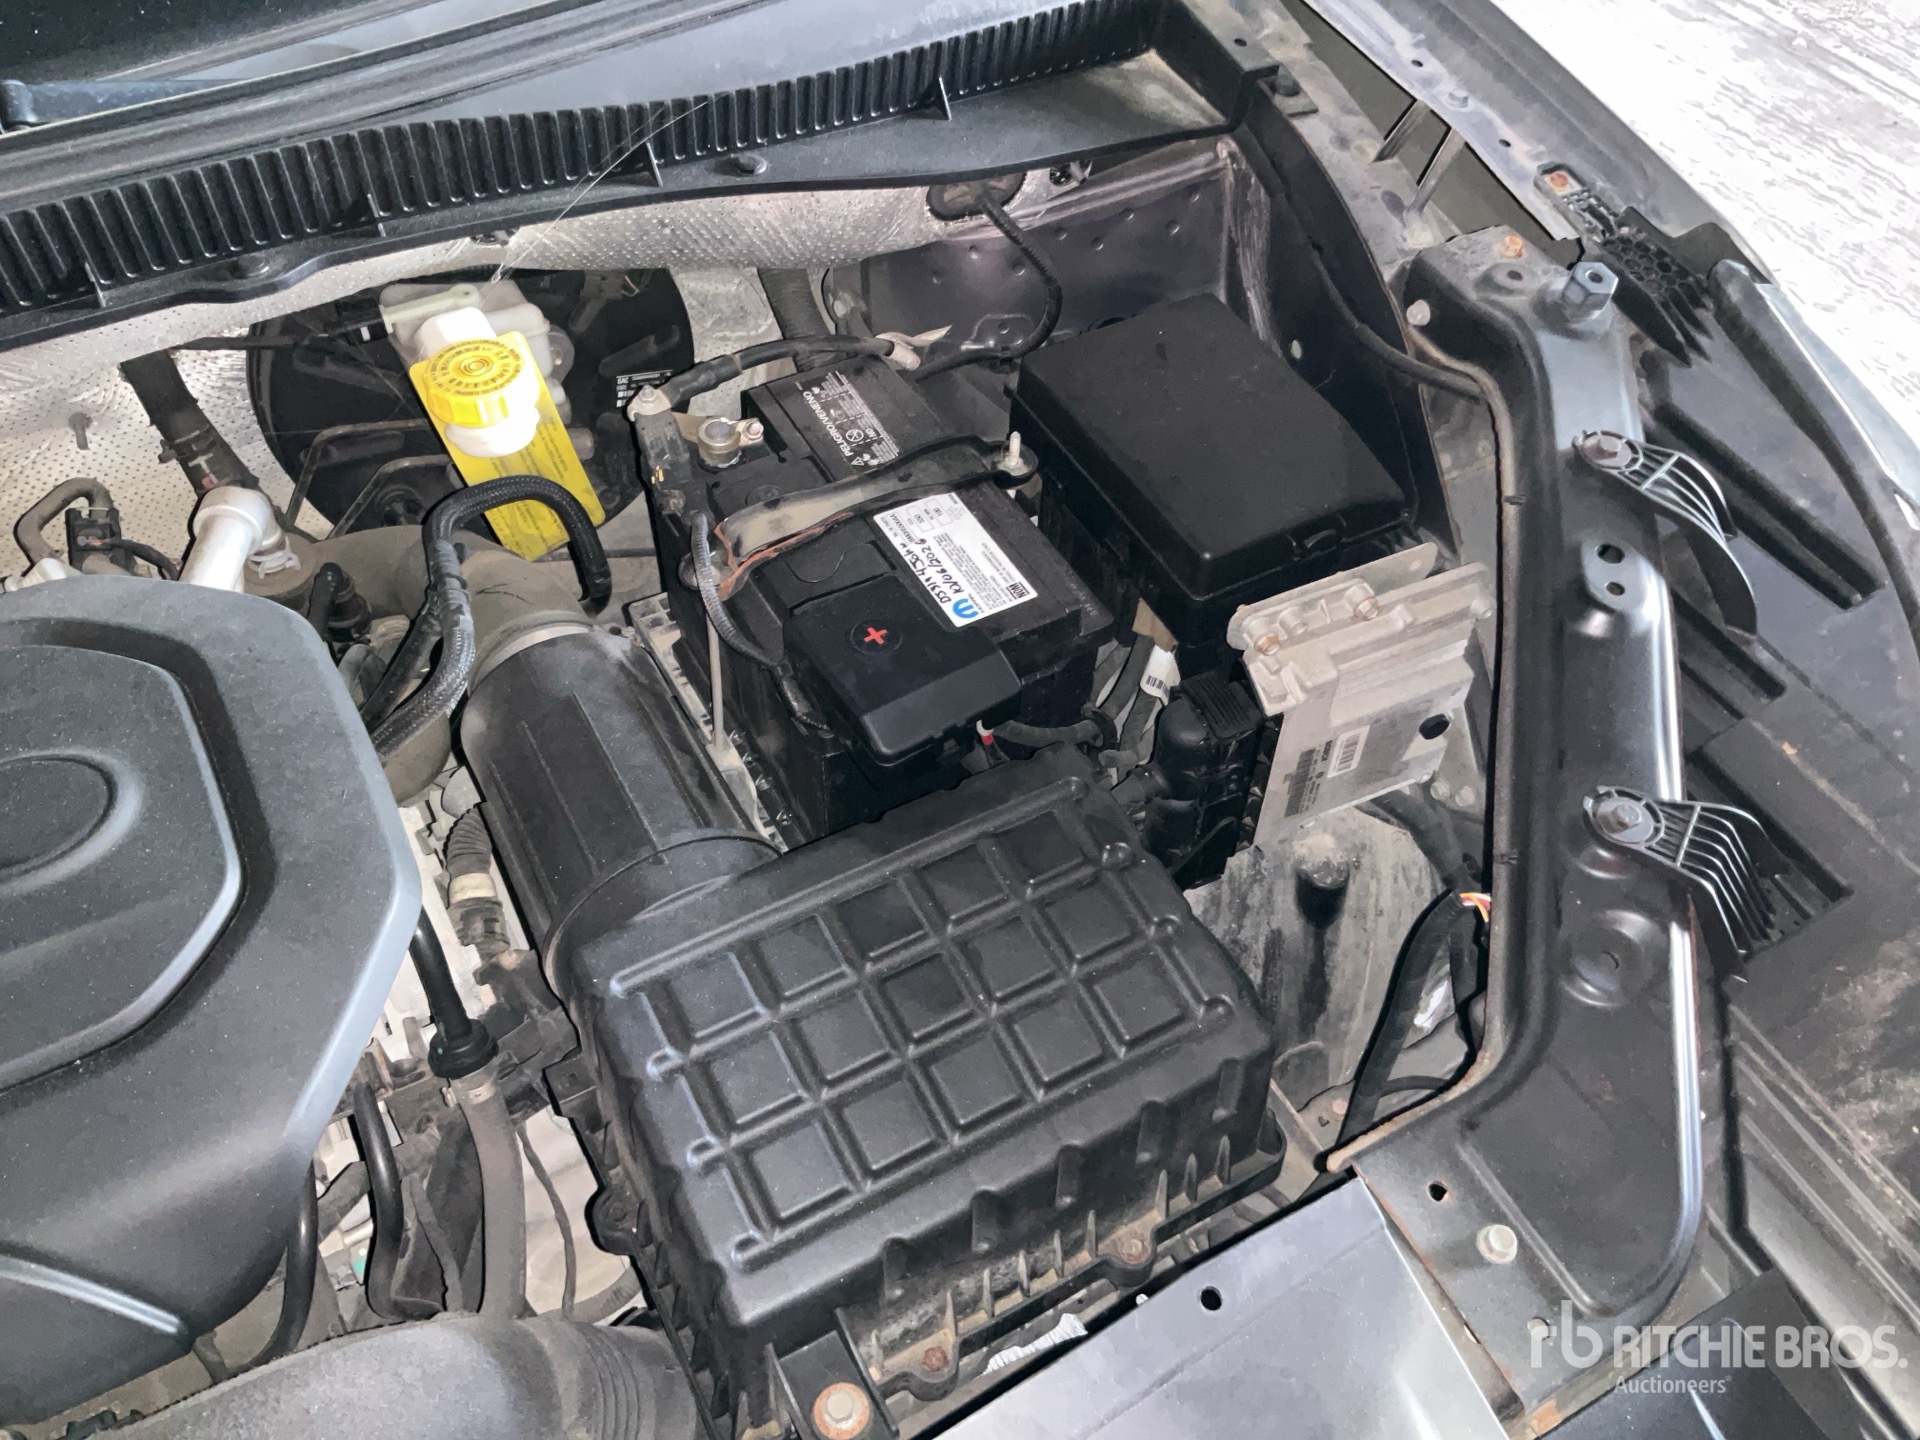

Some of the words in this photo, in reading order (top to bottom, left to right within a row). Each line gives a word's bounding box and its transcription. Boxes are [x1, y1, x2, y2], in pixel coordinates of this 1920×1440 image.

[803, 391, 854, 457] PELIGRO/VENENO
[932, 507, 944, 516] 100
[1007, 582, 1027, 598] NOM
